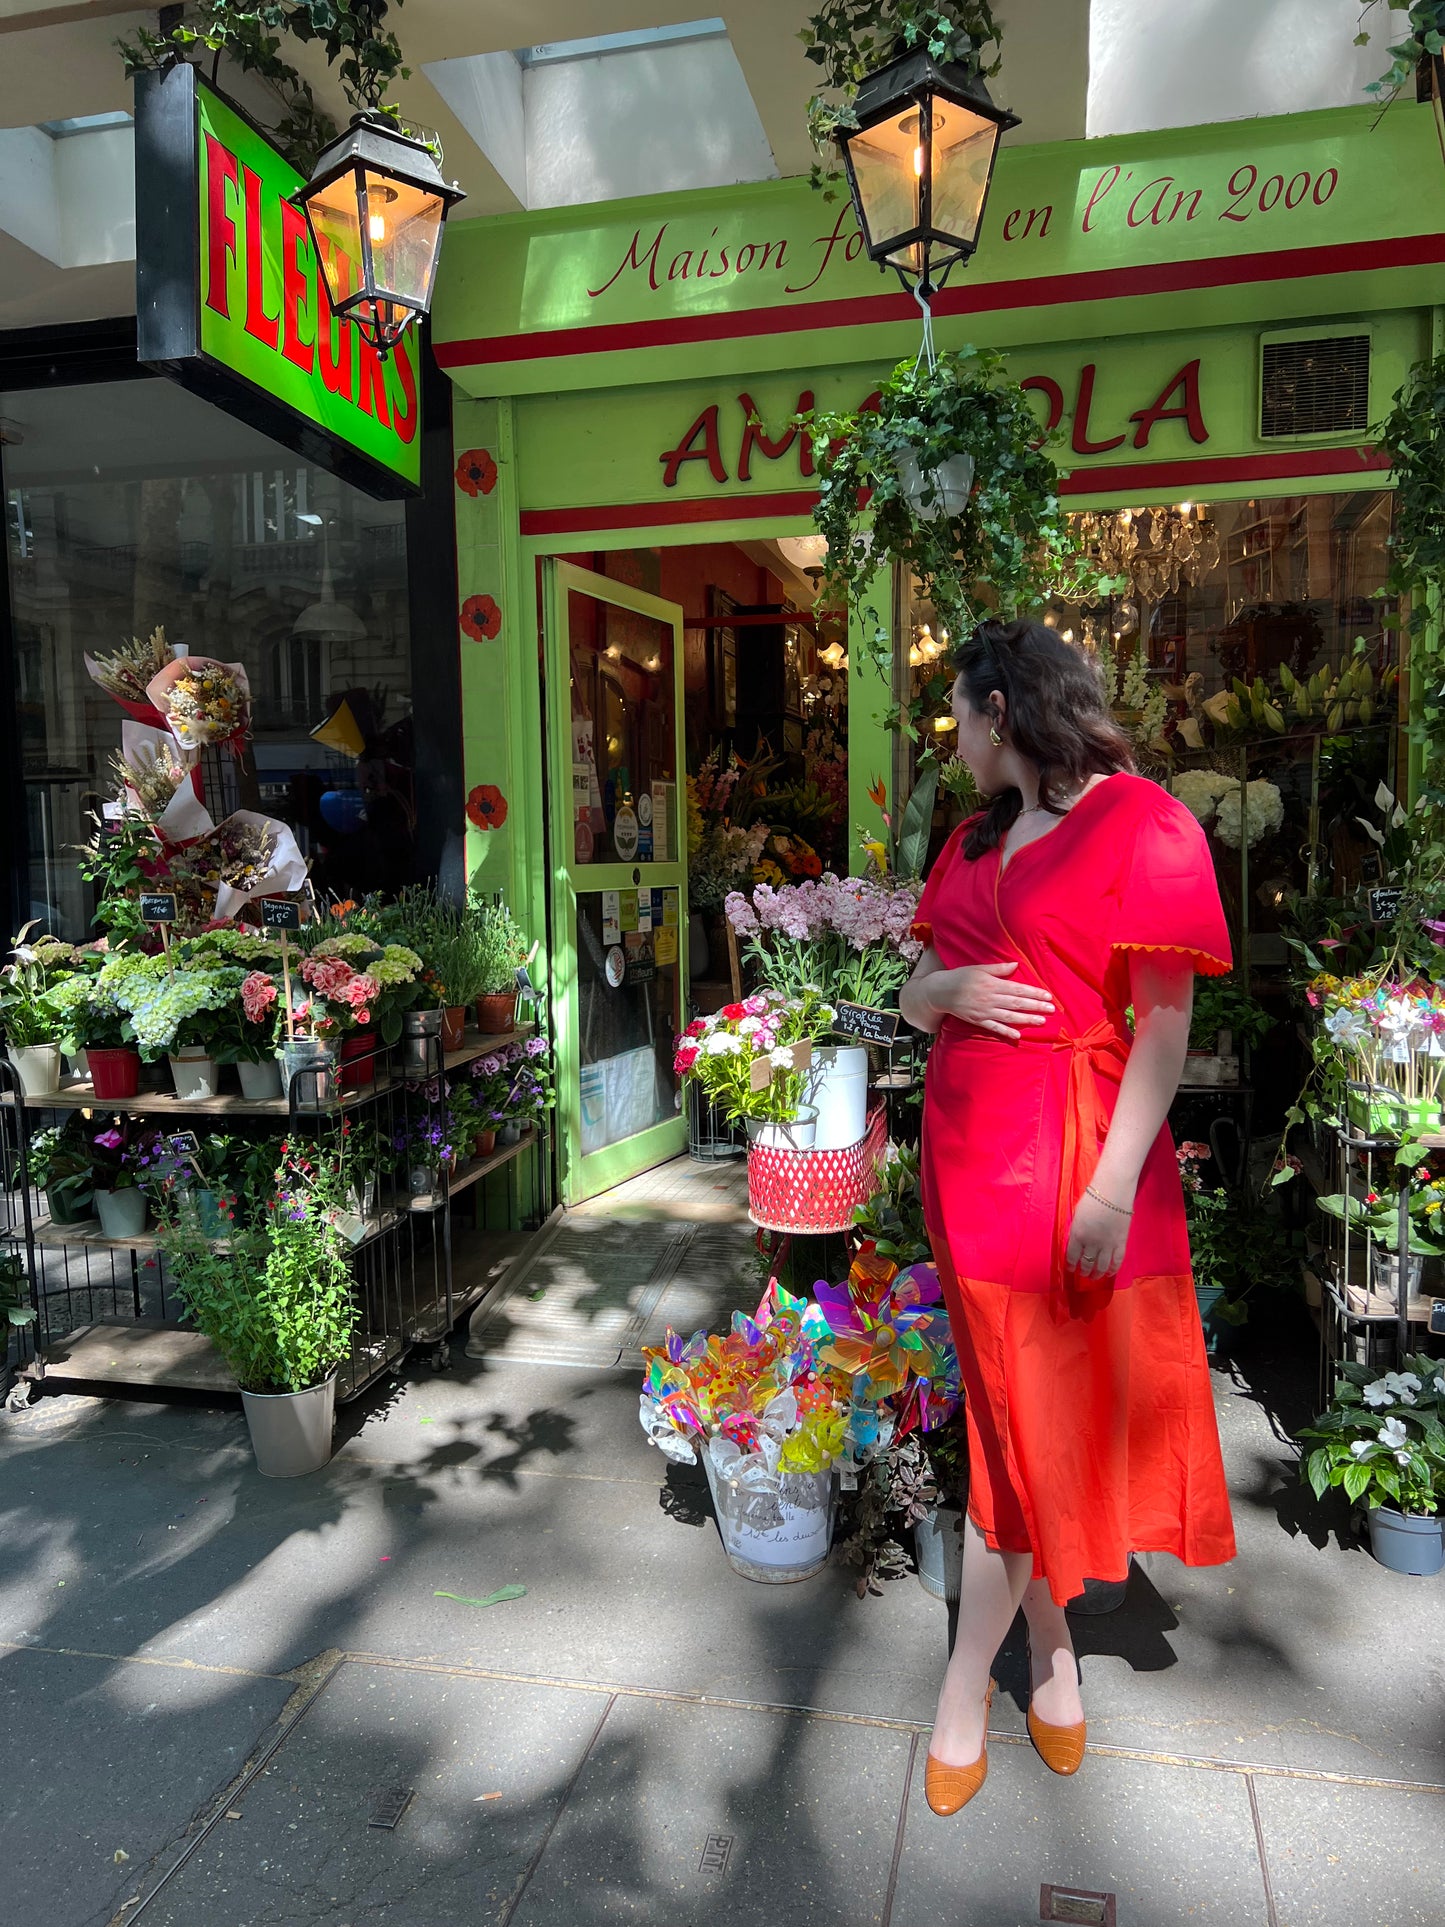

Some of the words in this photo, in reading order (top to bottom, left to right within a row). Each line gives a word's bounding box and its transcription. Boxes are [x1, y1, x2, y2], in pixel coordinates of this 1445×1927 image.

[587, 223, 787, 297] Maison
[1002, 205, 1052, 242] en
[1218, 164, 1338, 222] 2000
